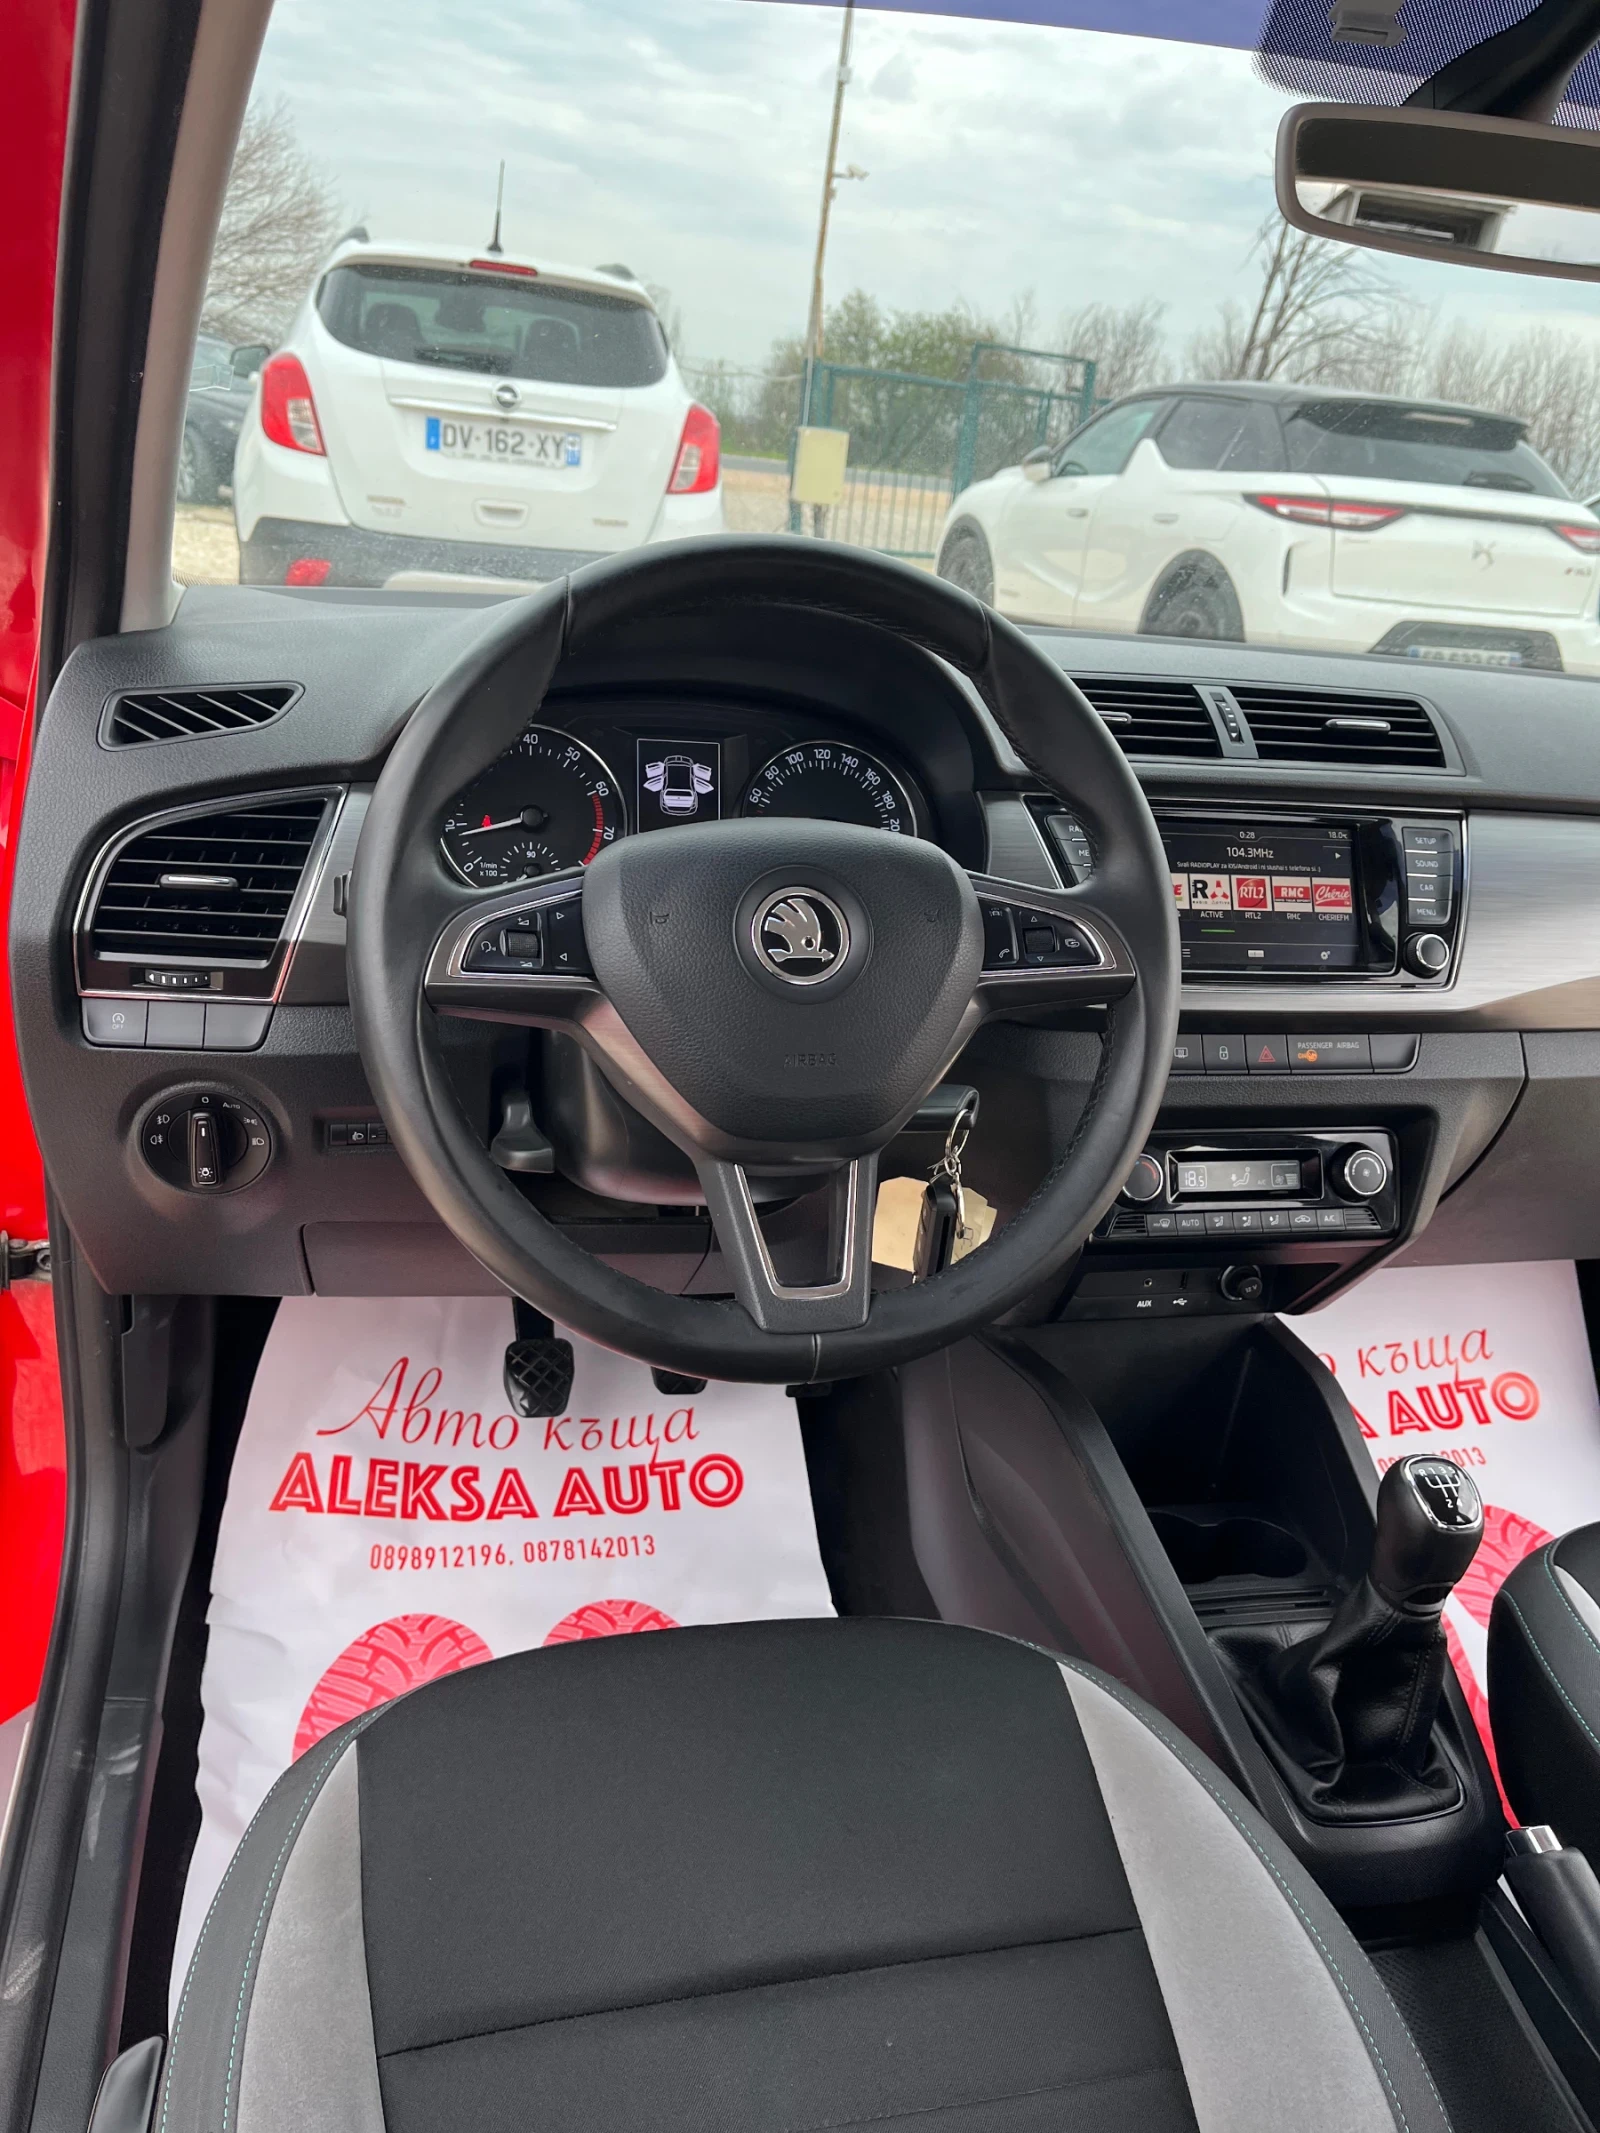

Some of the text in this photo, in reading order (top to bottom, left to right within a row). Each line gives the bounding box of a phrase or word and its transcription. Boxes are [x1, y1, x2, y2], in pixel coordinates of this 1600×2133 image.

[522, 733, 539, 744] 40
[564, 746, 581, 761] 50
[784, 751, 804, 766] 100
[814, 749, 831, 760] 120
[840, 753, 859, 768] 140
[764, 765, 780, 780] 80
[864, 768, 881, 786] 160
[595, 780, 609, 797] 60
[750, 787, 763, 804] 60
[882, 790, 896, 810] 180
[889, 818, 900, 832] 20
[603, 826, 615, 841] 70
[1239, 831, 1256, 839] 0:28
[1414, 836, 1437, 844] SETUP
[526, 850, 537, 858] 90
[1226, 846, 1274, 858] 104.3MHz
[1415, 860, 1438, 868] SOUND
[1240, 886, 1264, 899] RTL2
[1281, 887, 1304, 898] RMC
[1244, 912, 1262, 920] RTL2
[1416, 908, 1436, 916] MENU
[784, 1052, 837, 1068] AIRBAG
[1181, 1220, 1200, 1228] AUTO
[1324, 1214, 1336, 1222] A/C
[1136, 1300, 1152, 1308] AUX
[1357, 1328, 1494, 1379] къща
[316, 1356, 701, 1464] Авто къща
[1387, 1371, 1541, 1436] AUTO
[1418, 1468, 1428, 1476] R
[1438, 1466, 1447, 1474] 3
[269, 1452, 745, 1522] ALEKSA AUTO
[1446, 1498, 1454, 1508] 2
[369, 1534, 656, 1570] 0898912196, 0878142013
